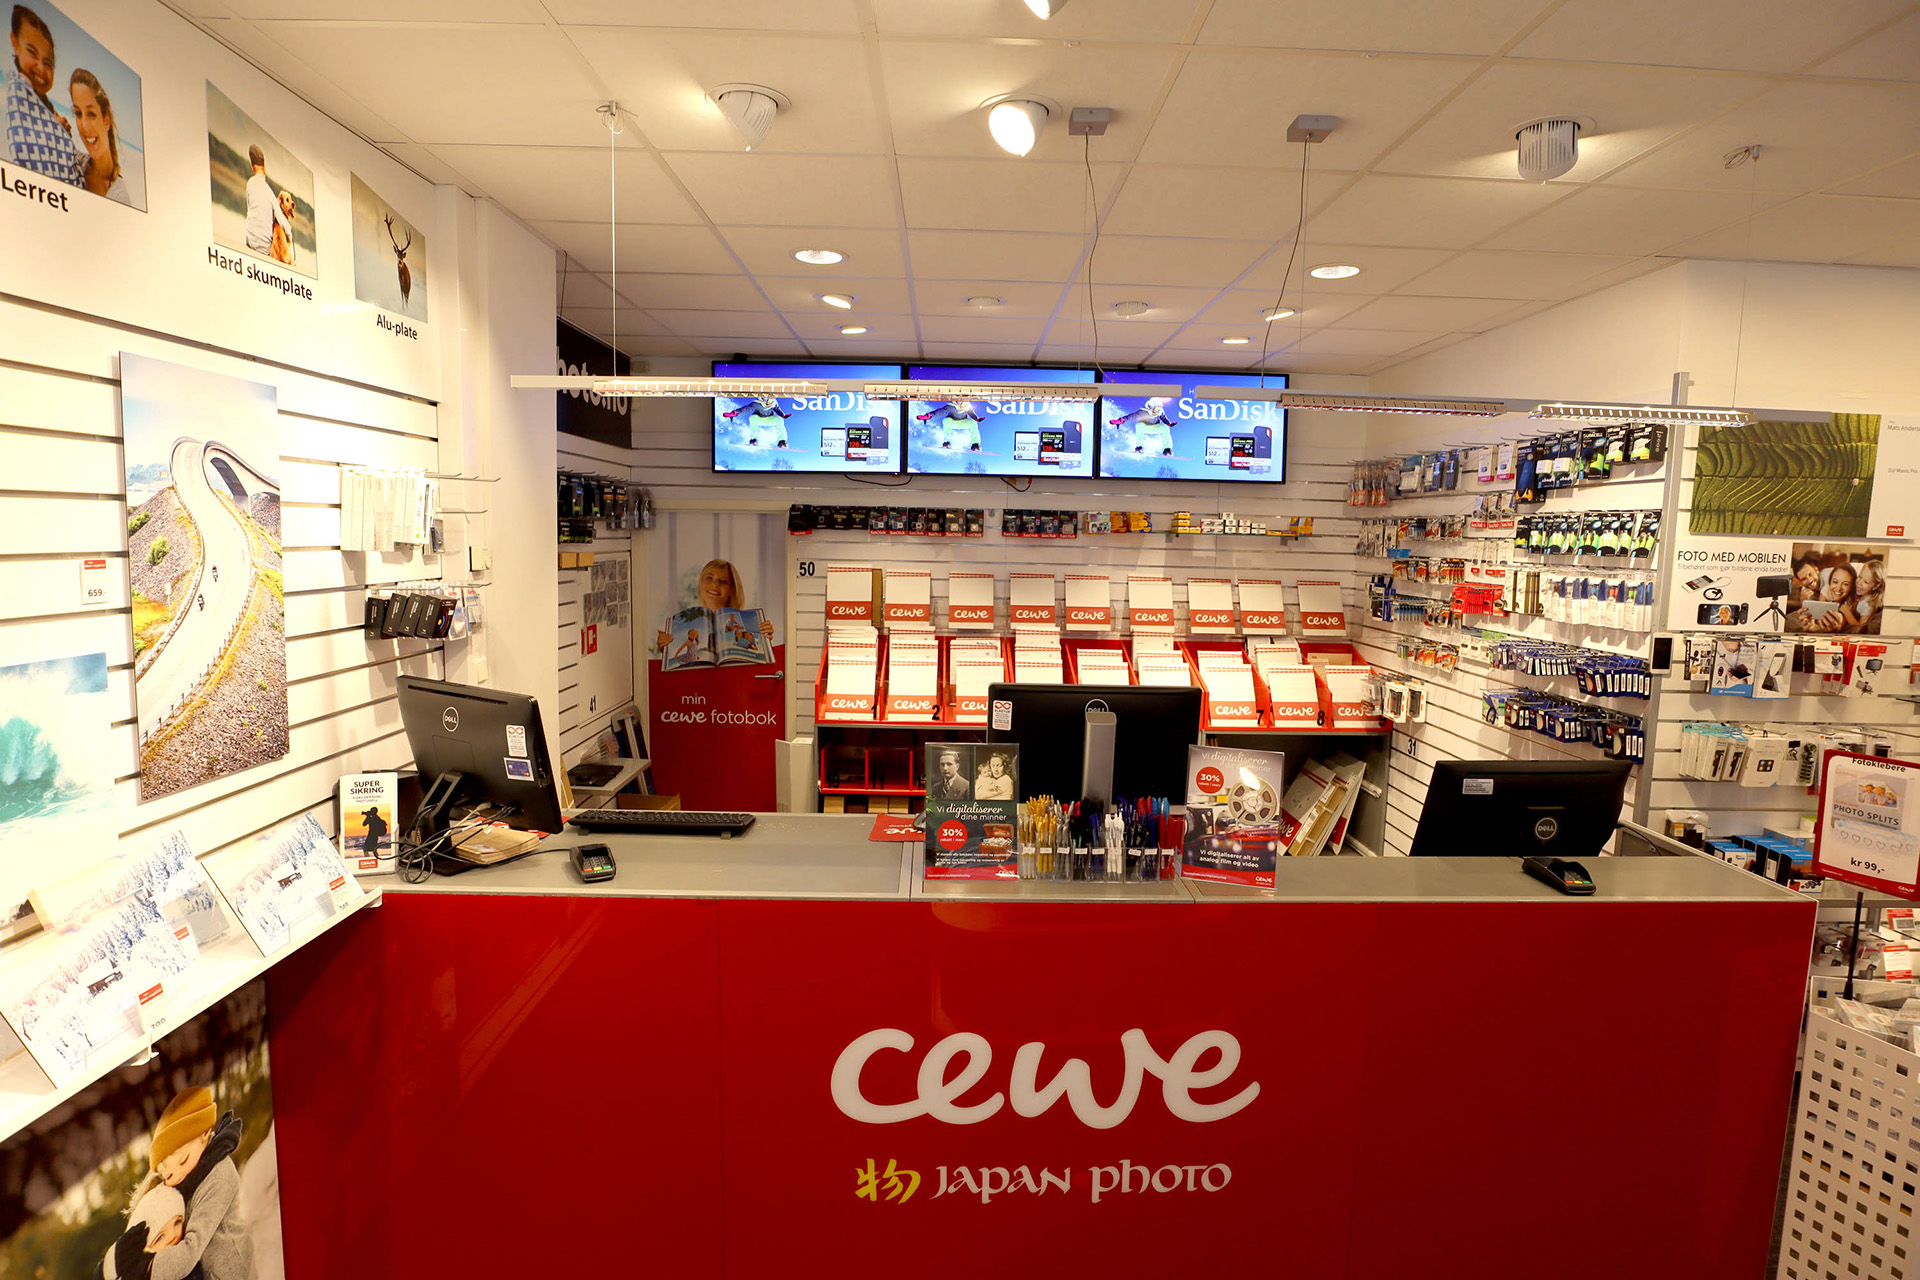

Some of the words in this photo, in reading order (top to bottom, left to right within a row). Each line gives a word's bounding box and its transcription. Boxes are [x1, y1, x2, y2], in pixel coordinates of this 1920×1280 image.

[1, 167, 68, 212] Lerret
[207, 246, 243, 275] Hard
[247, 264, 312, 300] skumplate
[377, 313, 418, 340] Alu-plate
[1178, 397, 1279, 422] SanDisk
[1678, 551, 1708, 562] FOTO
[1711, 552, 1735, 563] MED
[1738, 552, 1787, 564] MOBILEN
[799, 562, 815, 577] 50
[831, 605, 867, 616] cewe
[890, 607, 925, 617] cewe
[954, 609, 989, 619] cewe
[1015, 609, 1050, 619] cewe
[1071, 610, 1105, 621] cewe
[1135, 612, 1169, 622] cewe
[1195, 613, 1230, 624] cewe
[1246, 615, 1281, 625] cewe
[1306, 616, 1341, 626] cewe
[589, 695, 597, 714] 41
[681, 693, 706, 706] min
[831, 698, 869, 709] cewe
[894, 699, 932, 710] cewe
[961, 700, 988, 711] cew
[871, 703, 877, 719] 1
[932, 705, 940, 720] 2
[1215, 704, 1252, 716] cewe
[1278, 705, 1315, 716] cewe
[444, 715, 457, 724] DELL
[661, 710, 708, 724] cewe
[710, 709, 777, 725] fotobok
[1256, 710, 1265, 725] 7
[1317, 711, 1325, 726] 8
[1407, 738, 1417, 757] 31
[1210, 751, 1268, 766] digitaliserer
[1852, 757, 1906, 773] Fotoklebere
[1200, 773, 1220, 782] 30%
[353, 780, 380, 788] SUPER
[946, 801, 1003, 819] digitaliserer
[1833, 803, 1865, 817] PHOTO
[1867, 812, 1899, 826] SPLITS
[961, 813, 978, 821] dine
[942, 828, 963, 837] 30%
[1207, 849, 1243, 861] digitaliserer
[1199, 856, 1220, 864] analog
[1242, 860, 1259, 868] video
[1850, 857, 1863, 867] kr
[1864, 861, 1886, 874] 99,-
[830, 1028, 1260, 1129] cewe
